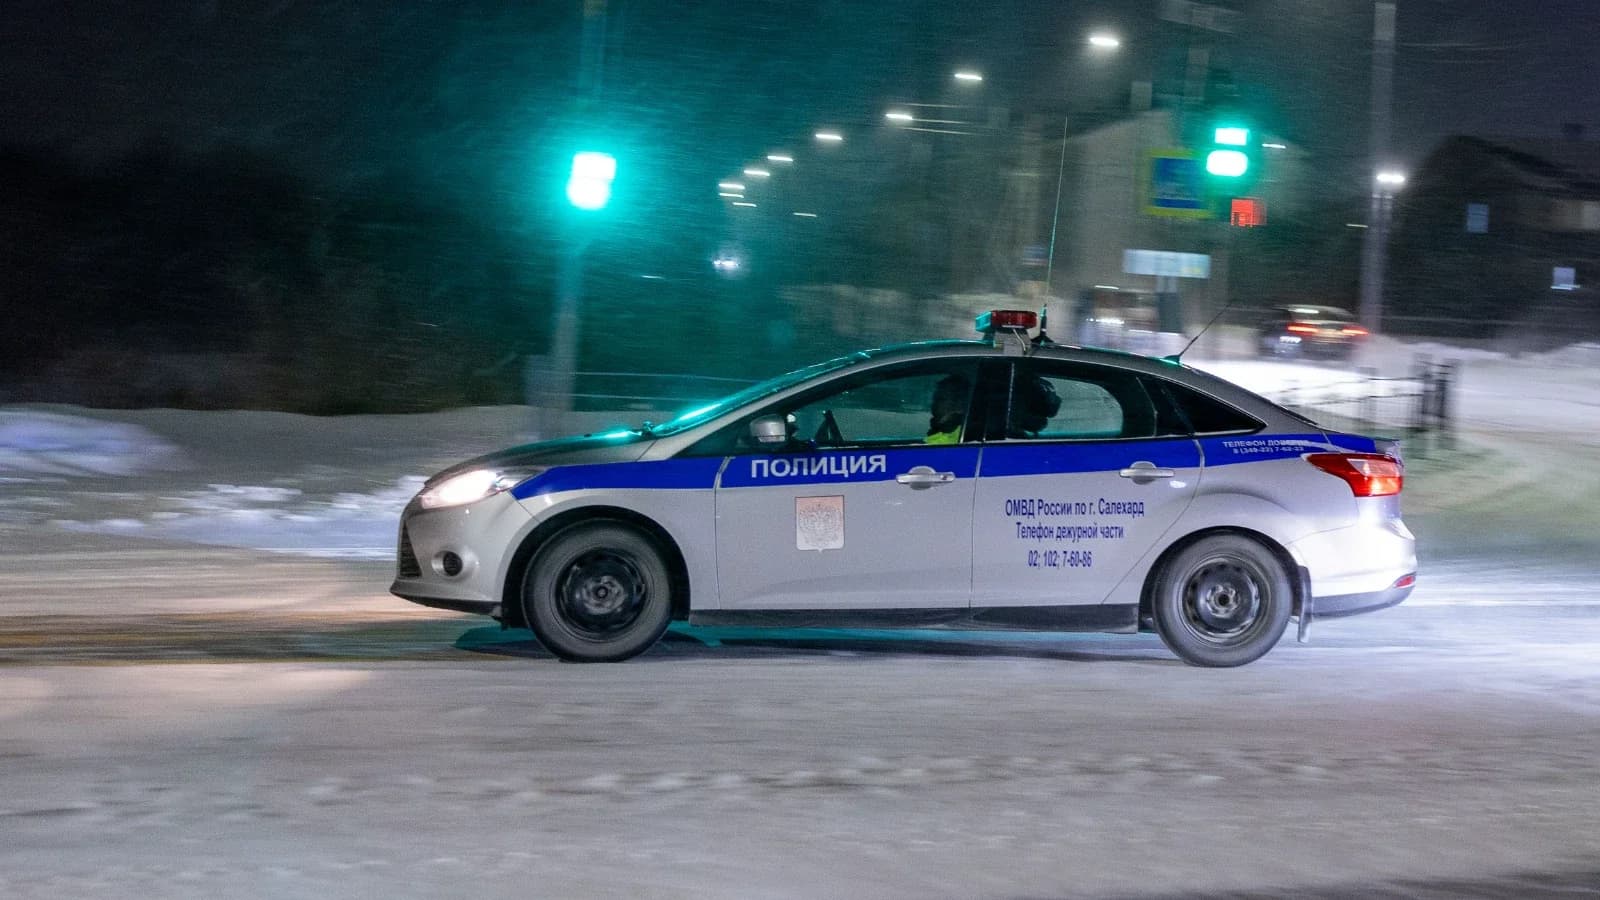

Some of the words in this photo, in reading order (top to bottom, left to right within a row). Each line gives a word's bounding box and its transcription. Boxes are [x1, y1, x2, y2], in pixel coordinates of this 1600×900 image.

[1223, 440, 1265, 448] ТЕЛЕФОН
[751, 455, 886, 478] ПОЛИЦИЯ
[1005, 499, 1034, 517] ОМВД
[1038, 499, 1072, 515] России
[1075, 502, 1086, 515] по
[1089, 502, 1096, 515] г.
[1099, 498, 1144, 517] Салехард
[1016, 522, 1053, 542] Телефон
[1056, 522, 1098, 543] дежурной
[1100, 525, 1124, 539] части
[1028, 550, 1041, 569] 02;
[1044, 550, 1060, 569] 102;
[1063, 550, 1092, 567] 7-60-86
